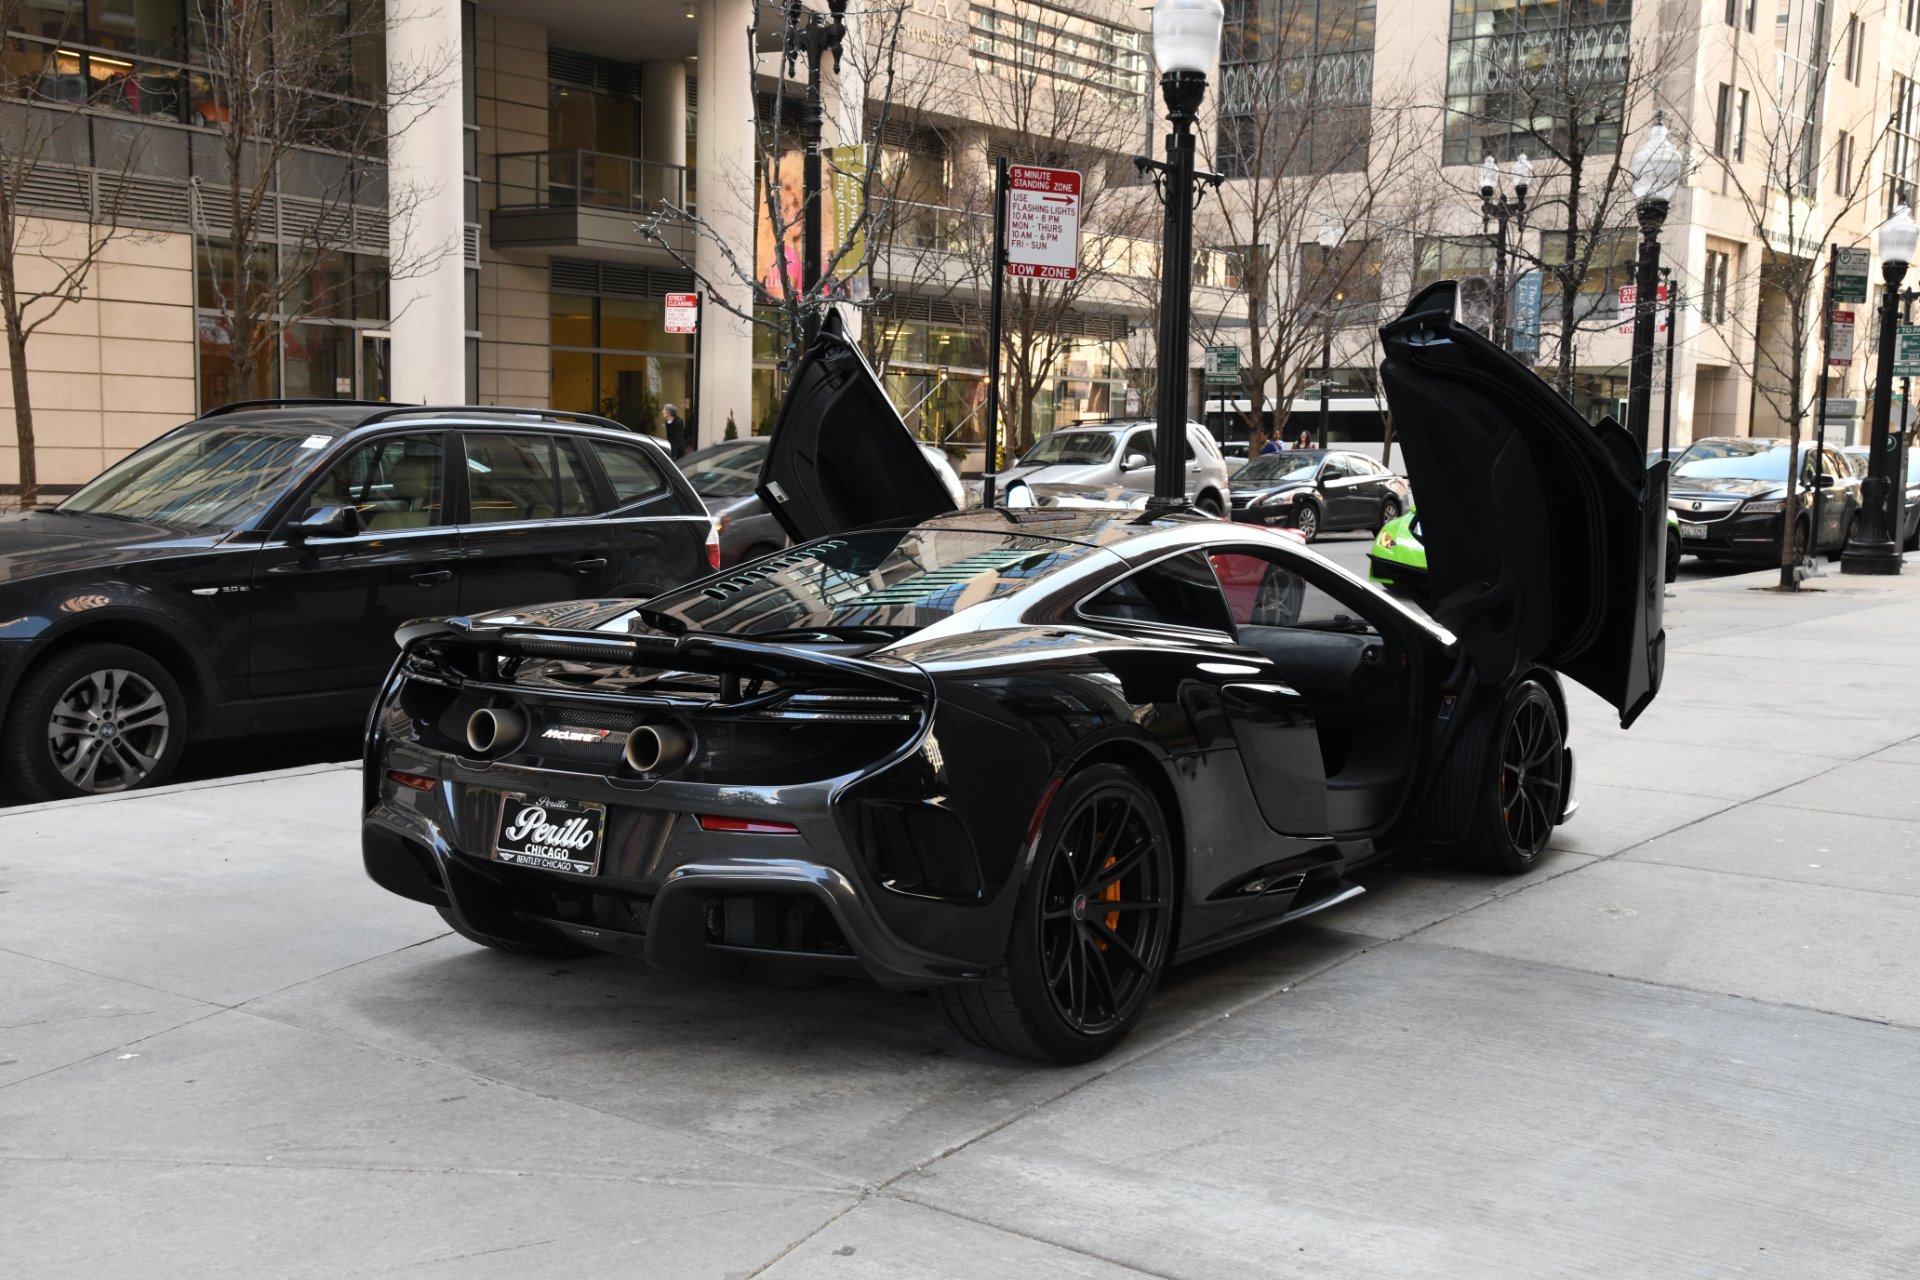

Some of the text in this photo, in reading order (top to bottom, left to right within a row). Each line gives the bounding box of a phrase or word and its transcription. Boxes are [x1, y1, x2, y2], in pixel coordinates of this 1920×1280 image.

[900, 22, 955, 49] HICAGO
[1014, 169, 1052, 181] 15 MINUTE
[1014, 178, 1073, 193] STANDING ZONE
[1013, 193, 1028, 202] USE
[1012, 203, 1076, 217] FLASHING LIGHTS
[1012, 221, 1029, 230] MON
[1037, 223, 1063, 233] THURS
[1011, 239, 1024, 248] FRI
[1031, 241, 1047, 250] SUN
[1010, 263, 1071, 279] TOW ZONE
[535, 796, 569, 809] Perillo
[505, 806, 594, 851] Perillo
[524, 843, 569, 860] CHICAGO
[516, 854, 572, 871] BENTLEY CHICAGO
